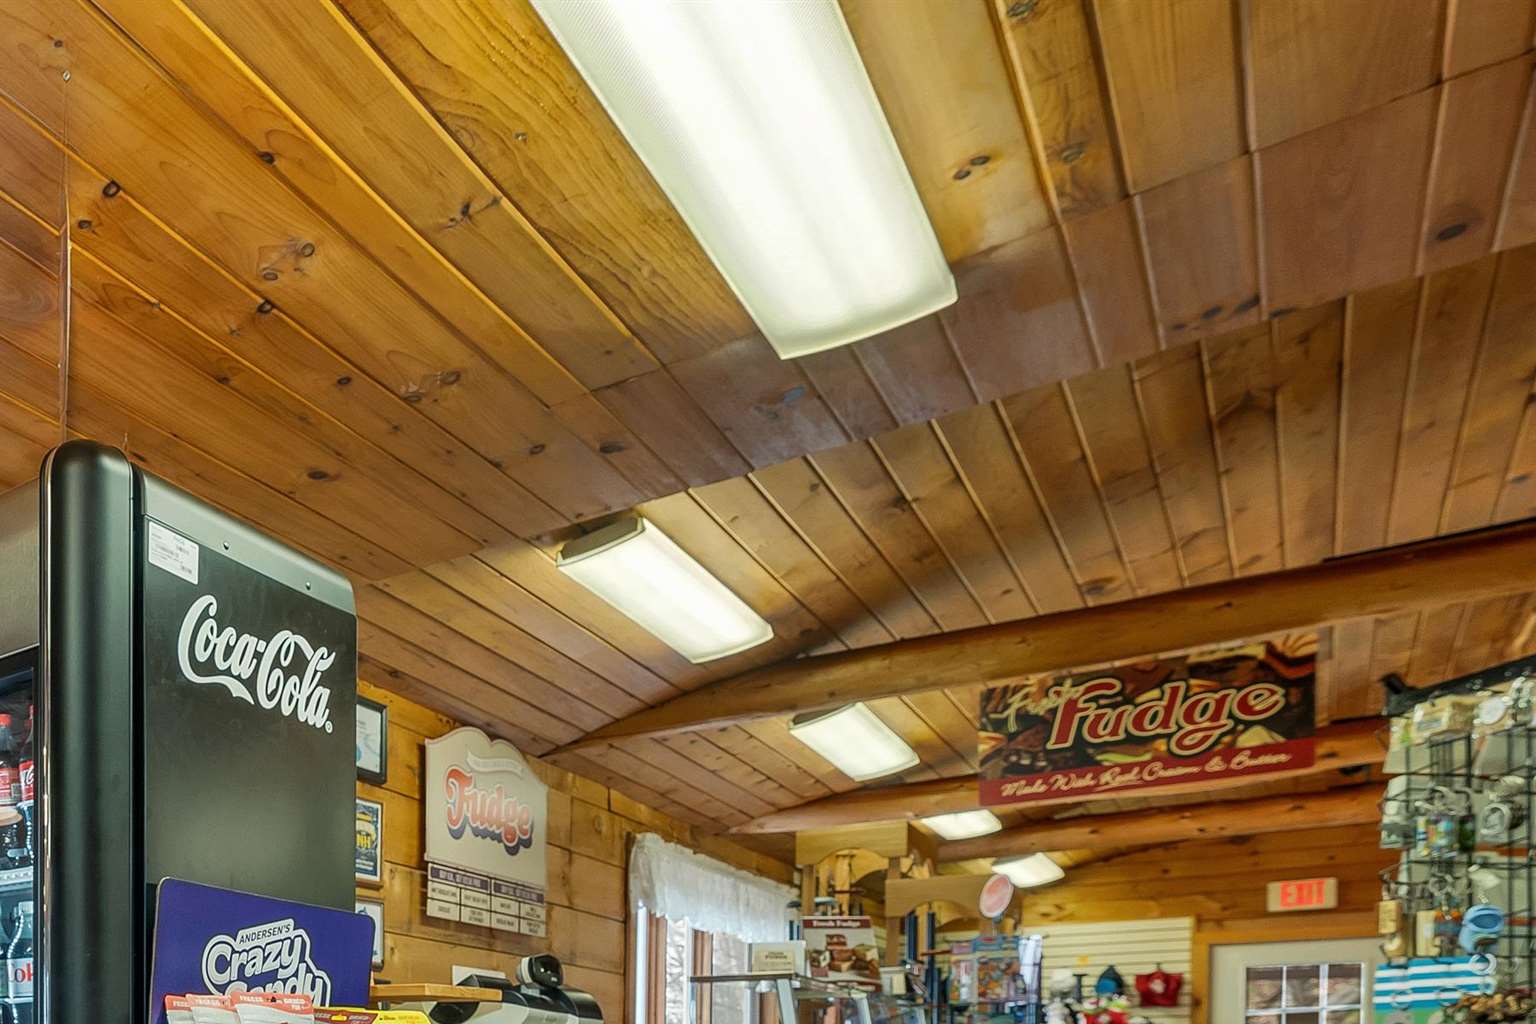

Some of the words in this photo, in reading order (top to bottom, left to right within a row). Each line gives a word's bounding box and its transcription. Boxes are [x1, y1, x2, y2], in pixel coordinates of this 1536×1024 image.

[178, 594, 336, 729] Coca-Cola
[1046, 677, 1285, 756] Fudge
[446, 766, 531, 848] Fudge
[1279, 880, 1326, 909] EXIT
[207, 936, 303, 985] Crazy
[239, 923, 292, 944] ANDERSEN'S
